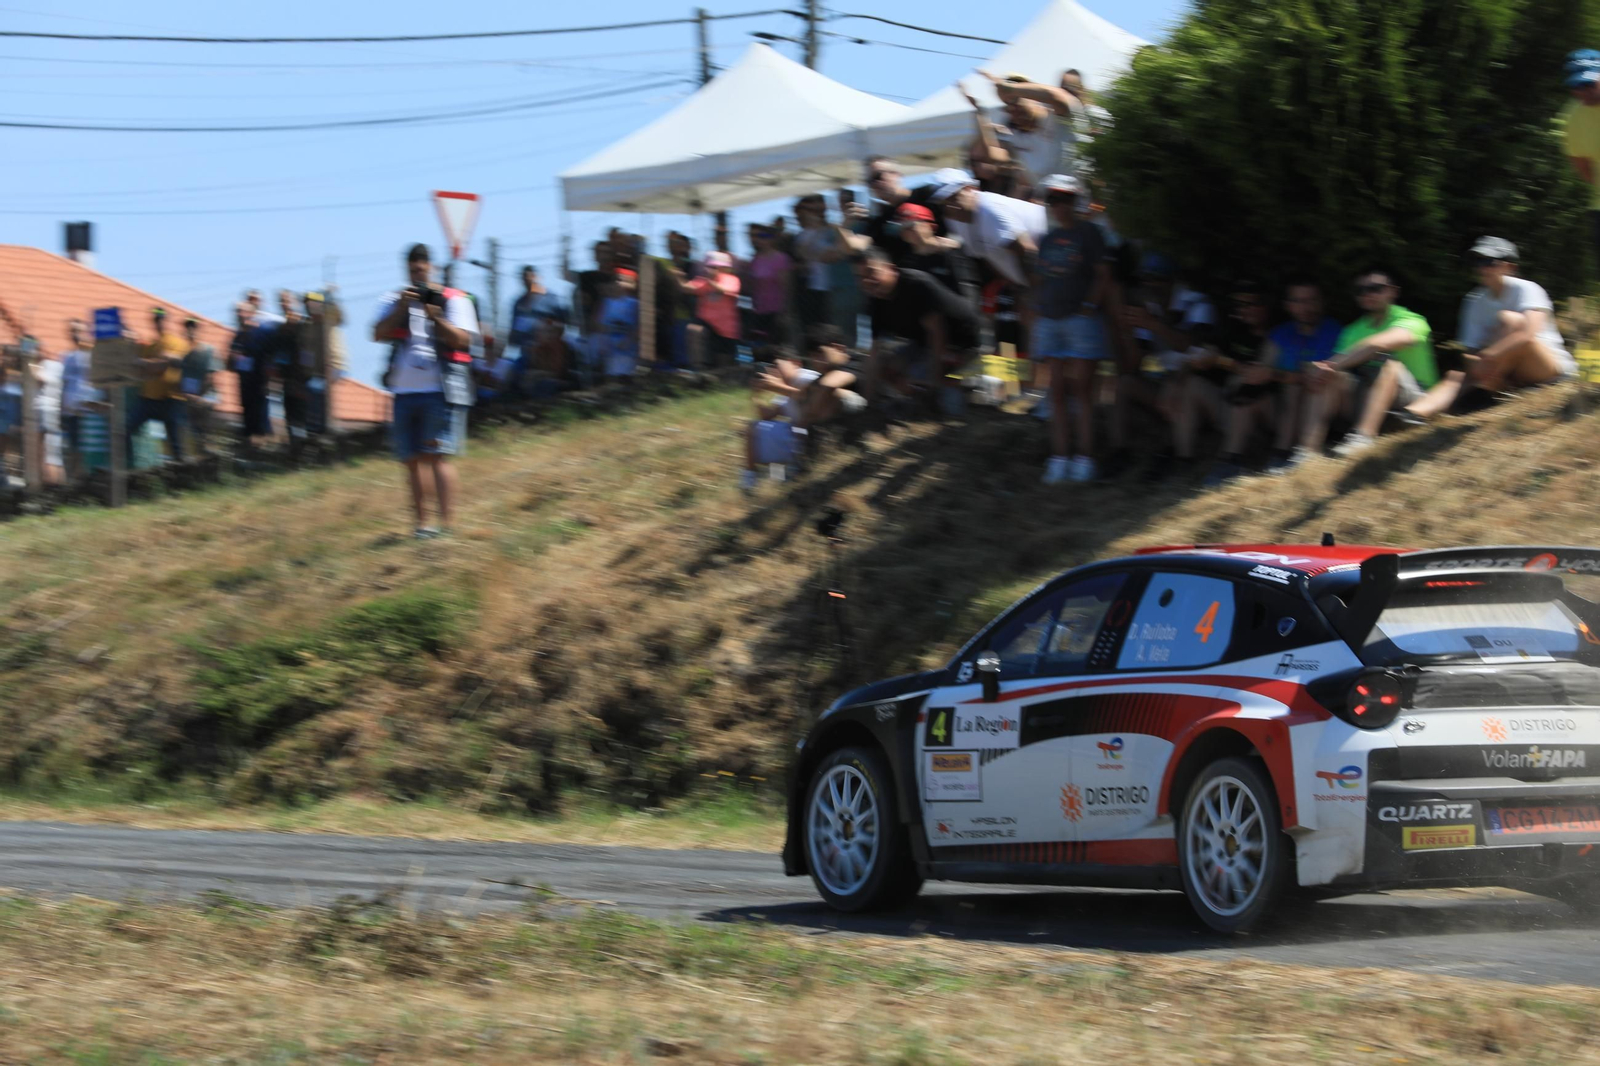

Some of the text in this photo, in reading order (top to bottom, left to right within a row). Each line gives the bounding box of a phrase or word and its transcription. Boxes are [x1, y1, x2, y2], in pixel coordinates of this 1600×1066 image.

[1193, 601, 1221, 643] 4
[931, 710, 947, 743] 4
[954, 715, 973, 732] La
[1509, 718, 1577, 732] DISTRIGO
[1541, 749, 1586, 768] FAPA
[1085, 786, 1150, 805] DISTRIGO
[1378, 803, 1473, 823] QUARTZ
[1410, 829, 1469, 846] PIRELLI
